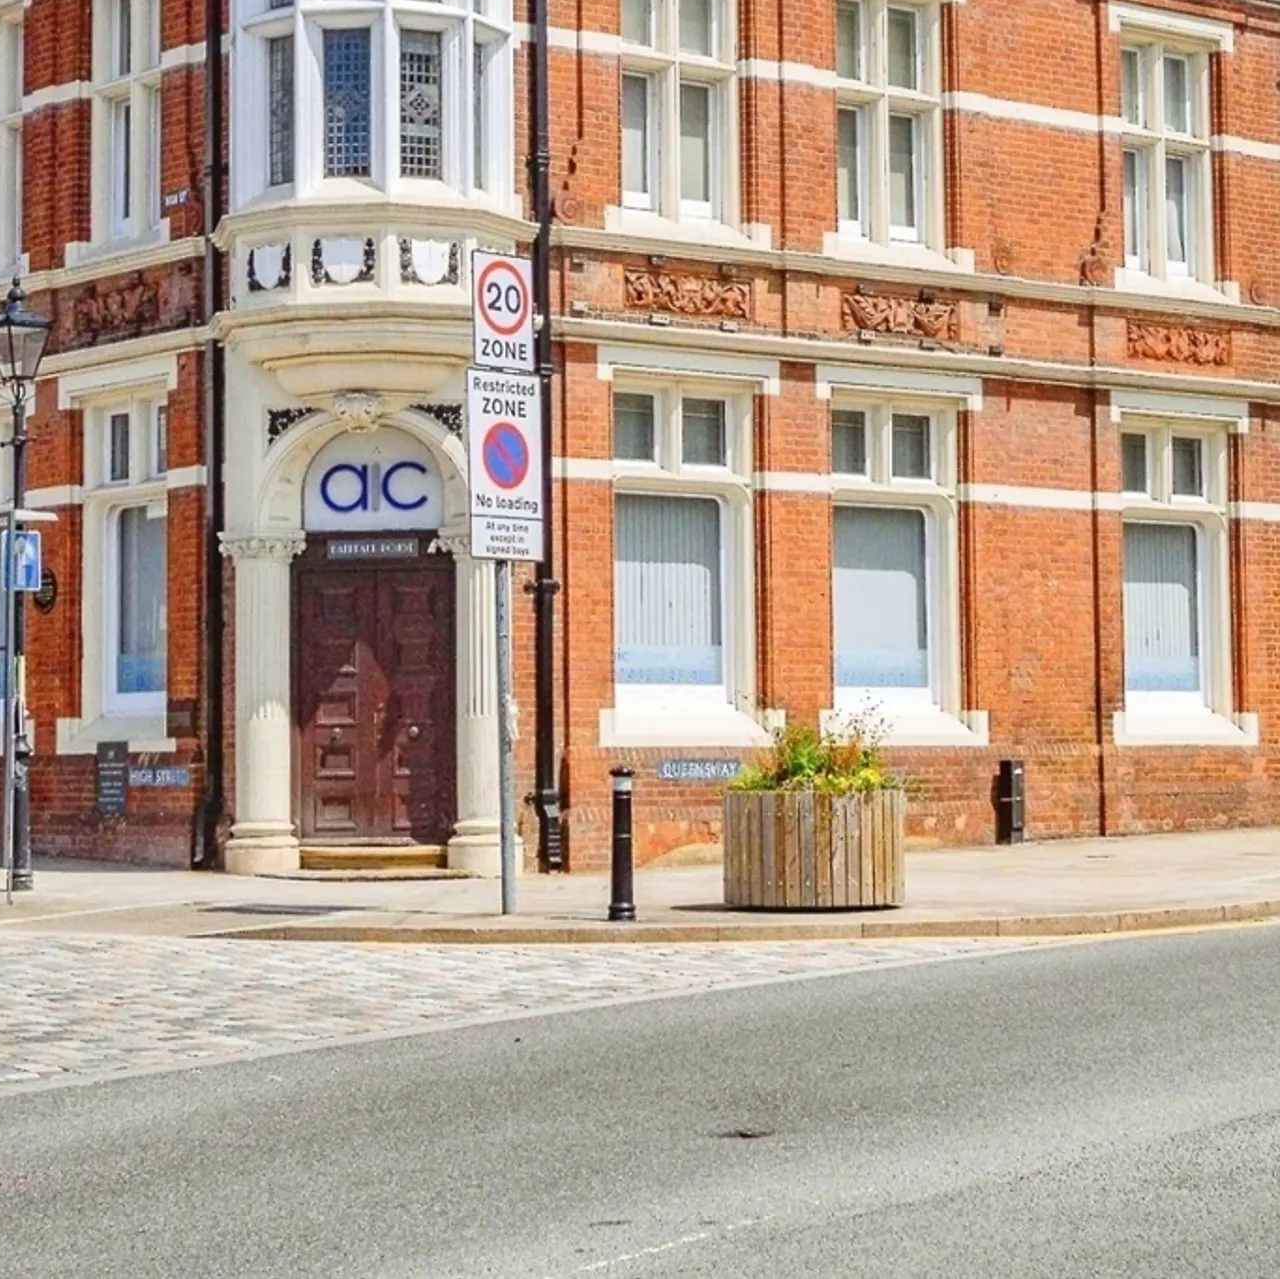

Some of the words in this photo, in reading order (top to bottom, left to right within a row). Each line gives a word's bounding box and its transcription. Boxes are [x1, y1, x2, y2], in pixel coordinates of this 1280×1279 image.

[487, 282, 521, 314] 20
[481, 338, 527, 361] ZONE
[473, 376, 535, 396] Restricted
[482, 396, 527, 418] ZONE
[476, 493, 493, 508] No
[495, 494, 538, 514] loading
[663, 762, 738, 778] QUEENSWAY
